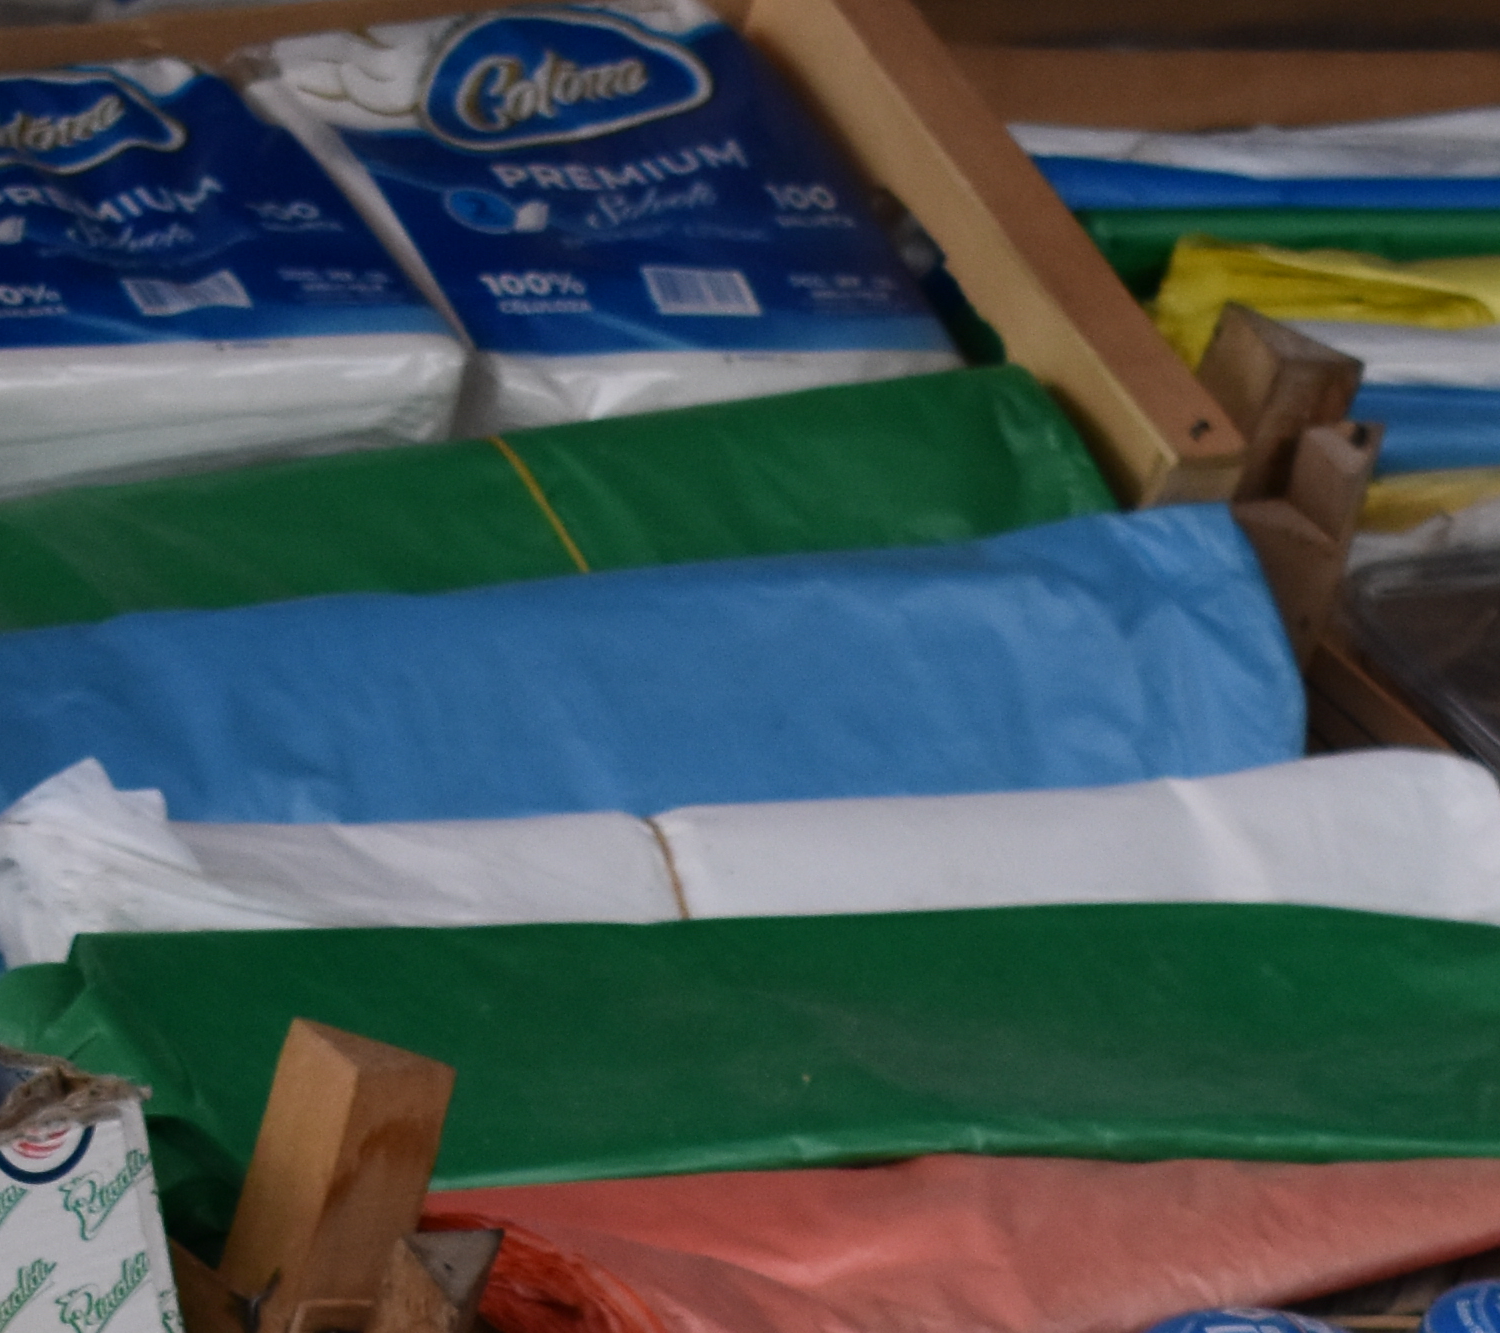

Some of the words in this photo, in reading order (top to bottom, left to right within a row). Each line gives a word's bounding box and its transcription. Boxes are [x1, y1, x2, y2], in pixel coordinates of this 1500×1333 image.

[491, 139, 749, 191] PREMIUM
[766, 183, 836, 210] 100
[479, 271, 586, 298] 100%
